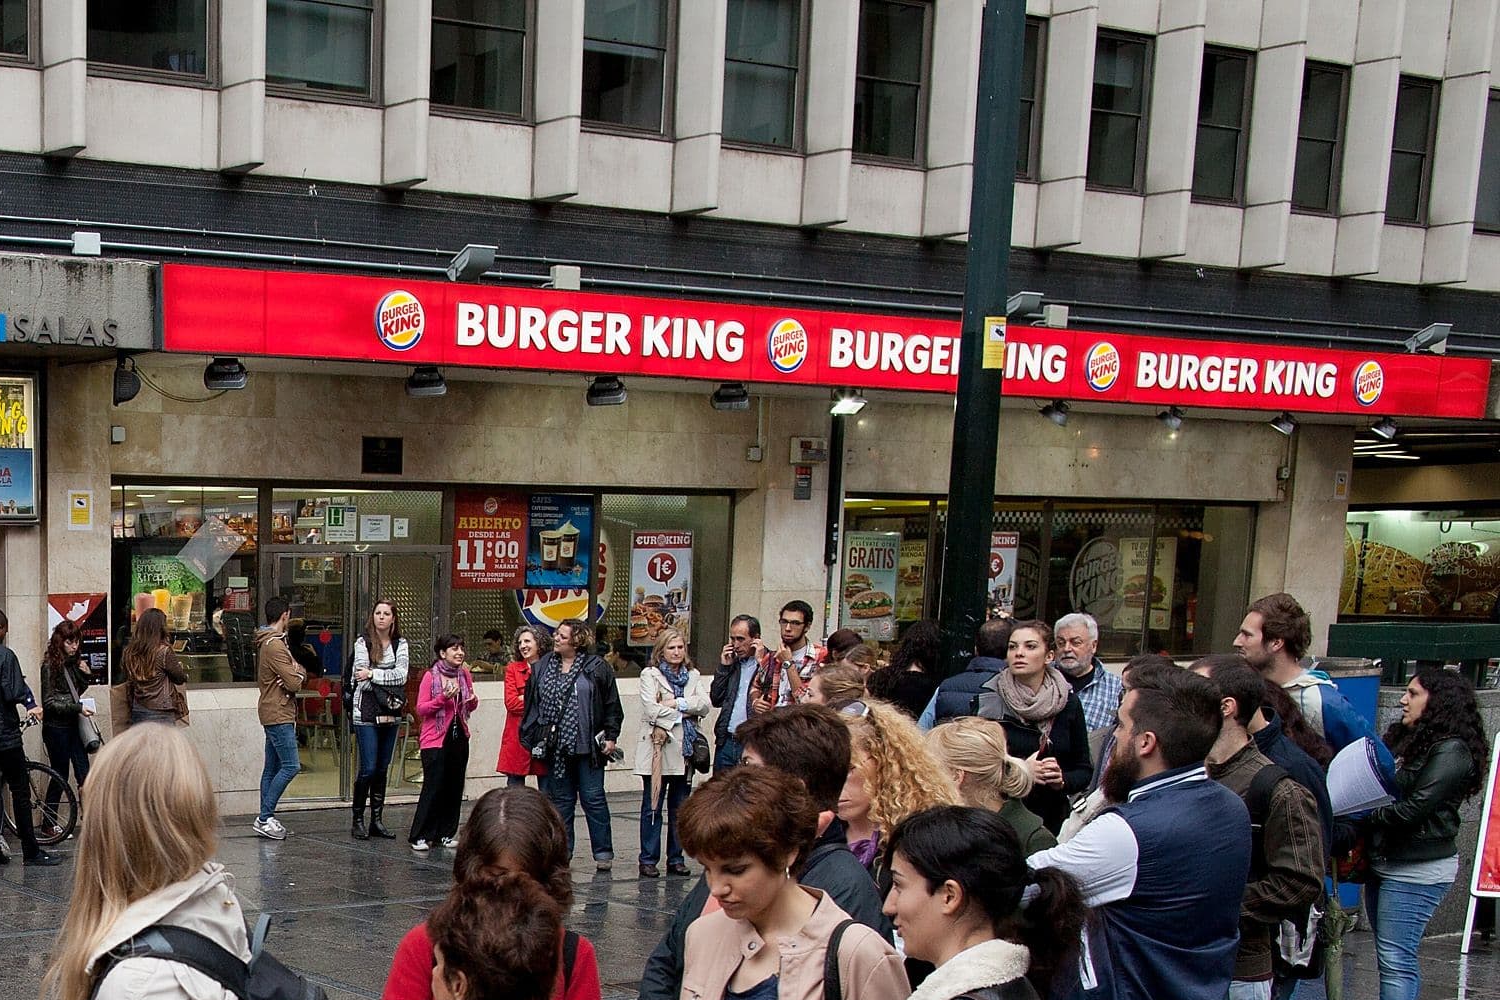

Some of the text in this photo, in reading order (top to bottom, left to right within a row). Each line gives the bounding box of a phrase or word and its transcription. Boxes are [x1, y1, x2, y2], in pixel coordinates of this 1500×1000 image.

[382, 303, 419, 323] BURGER
[12, 315, 119, 348] SALAS
[383, 313, 421, 338] KING
[456, 301, 746, 363] BURGER KING
[773, 330, 804, 347] BURGER
[773, 340, 805, 361] KING
[1090, 351, 1116, 369] BURGER
[1003, 341, 1068, 384] ING
[1090, 360, 1117, 381] KING
[1135, 350, 1338, 398] BURGER KING
[1358, 369, 1381, 385] BURGER
[1358, 378, 1381, 395] KING
[457, 516, 522, 530] ABIERTO
[468, 531, 511, 539] DESDE LAS
[457, 539, 519, 571] 11:00
[848, 546, 895, 570] GRATIS
[653, 557, 672, 580] 1€
